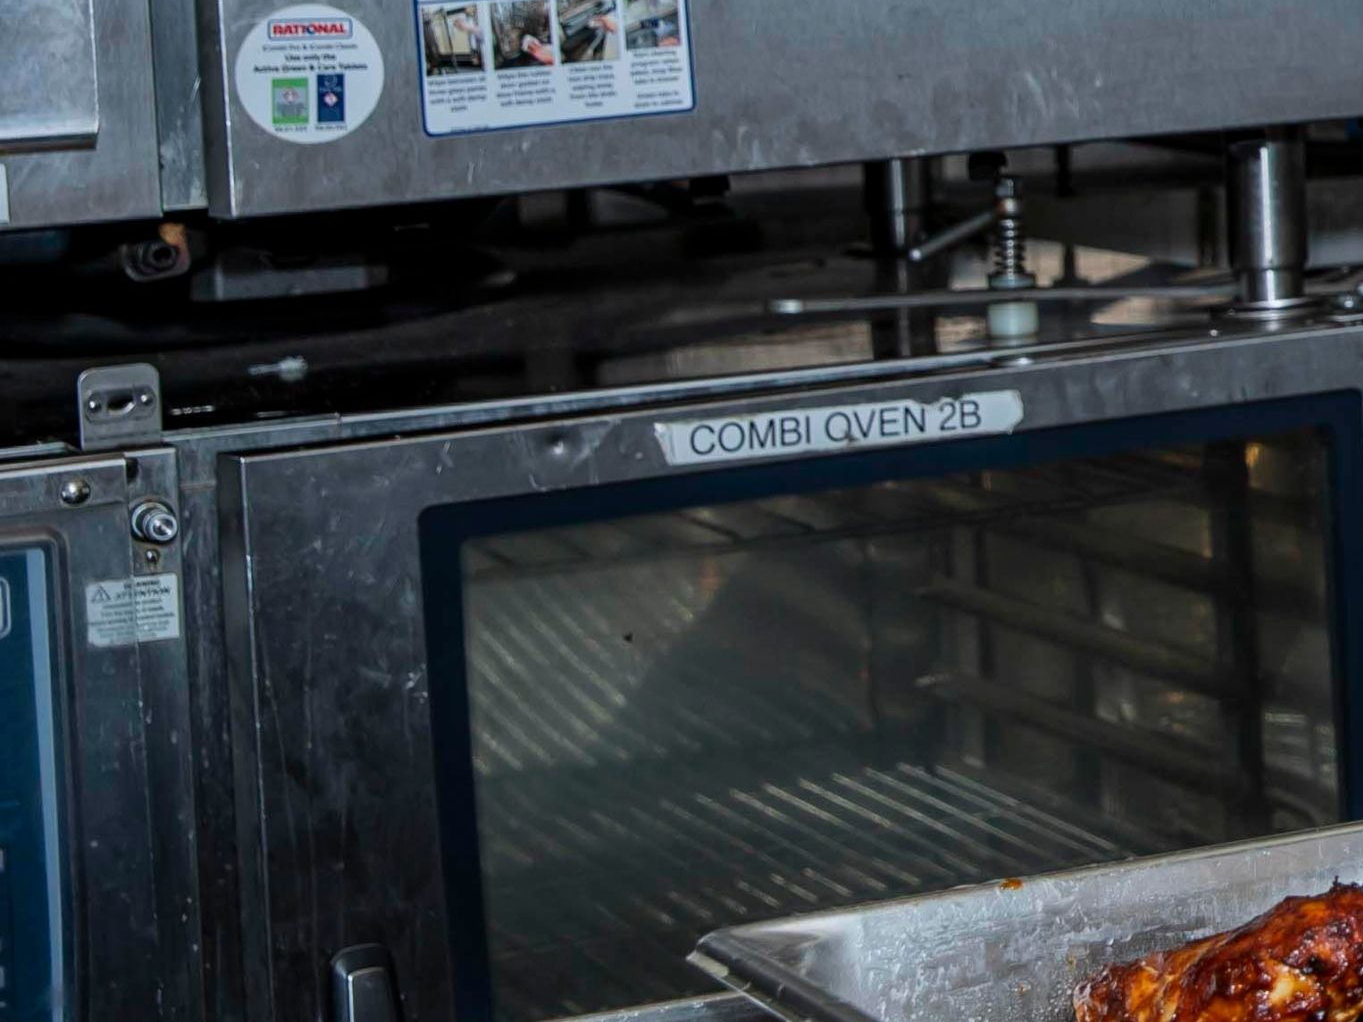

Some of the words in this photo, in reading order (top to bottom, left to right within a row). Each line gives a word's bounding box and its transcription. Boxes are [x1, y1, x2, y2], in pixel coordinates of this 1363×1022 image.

[272, 22, 346, 36] RATIONAL
[690, 415, 812, 456] COMBI
[938, 399, 982, 431] 2B
